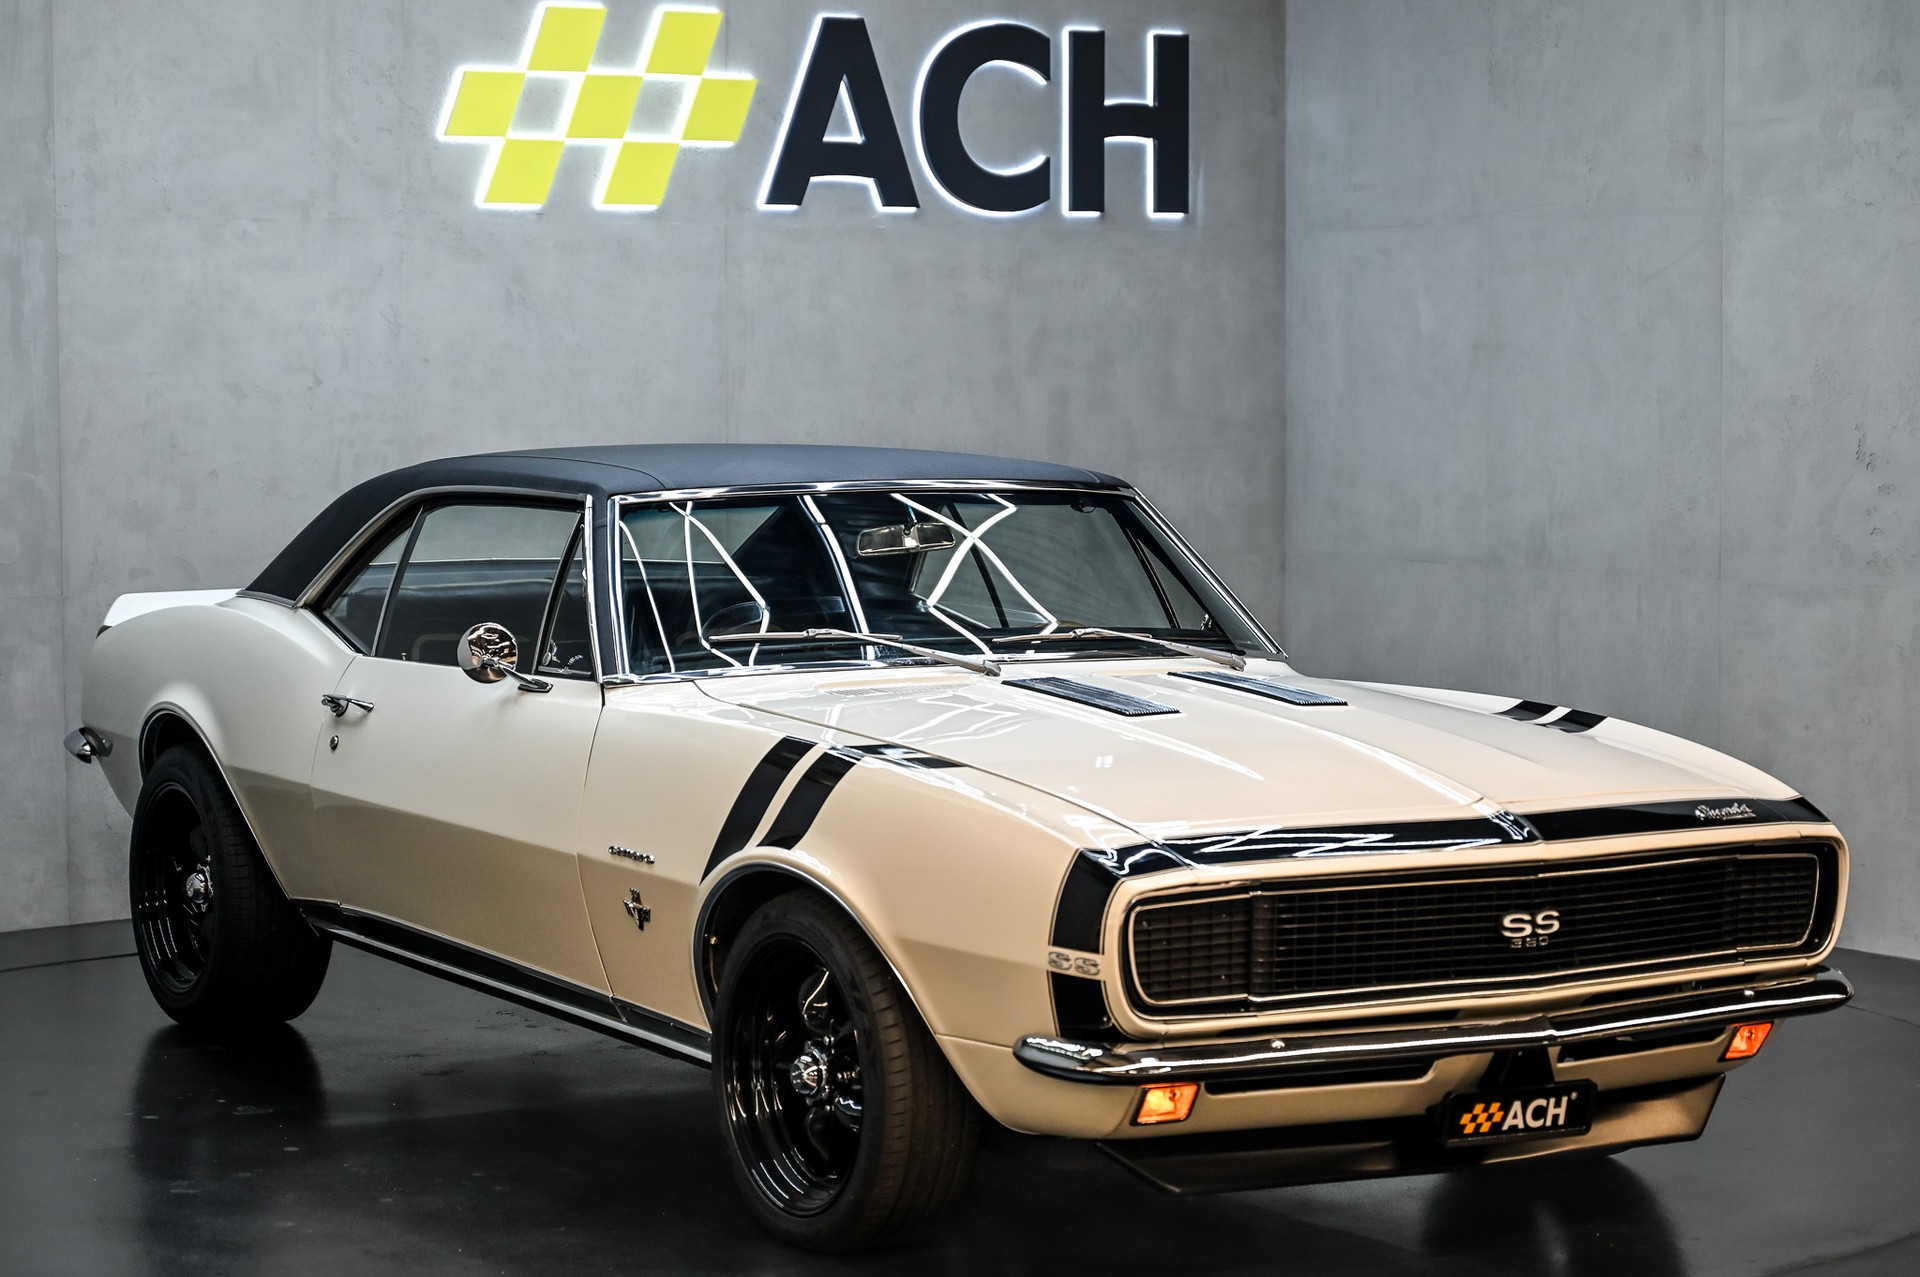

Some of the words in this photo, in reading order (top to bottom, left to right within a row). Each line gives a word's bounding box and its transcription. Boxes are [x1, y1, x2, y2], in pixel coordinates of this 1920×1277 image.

[760, 15, 1191, 215] ACH
[1502, 910, 1560, 937] SS
[1047, 951, 1101, 975] SS
